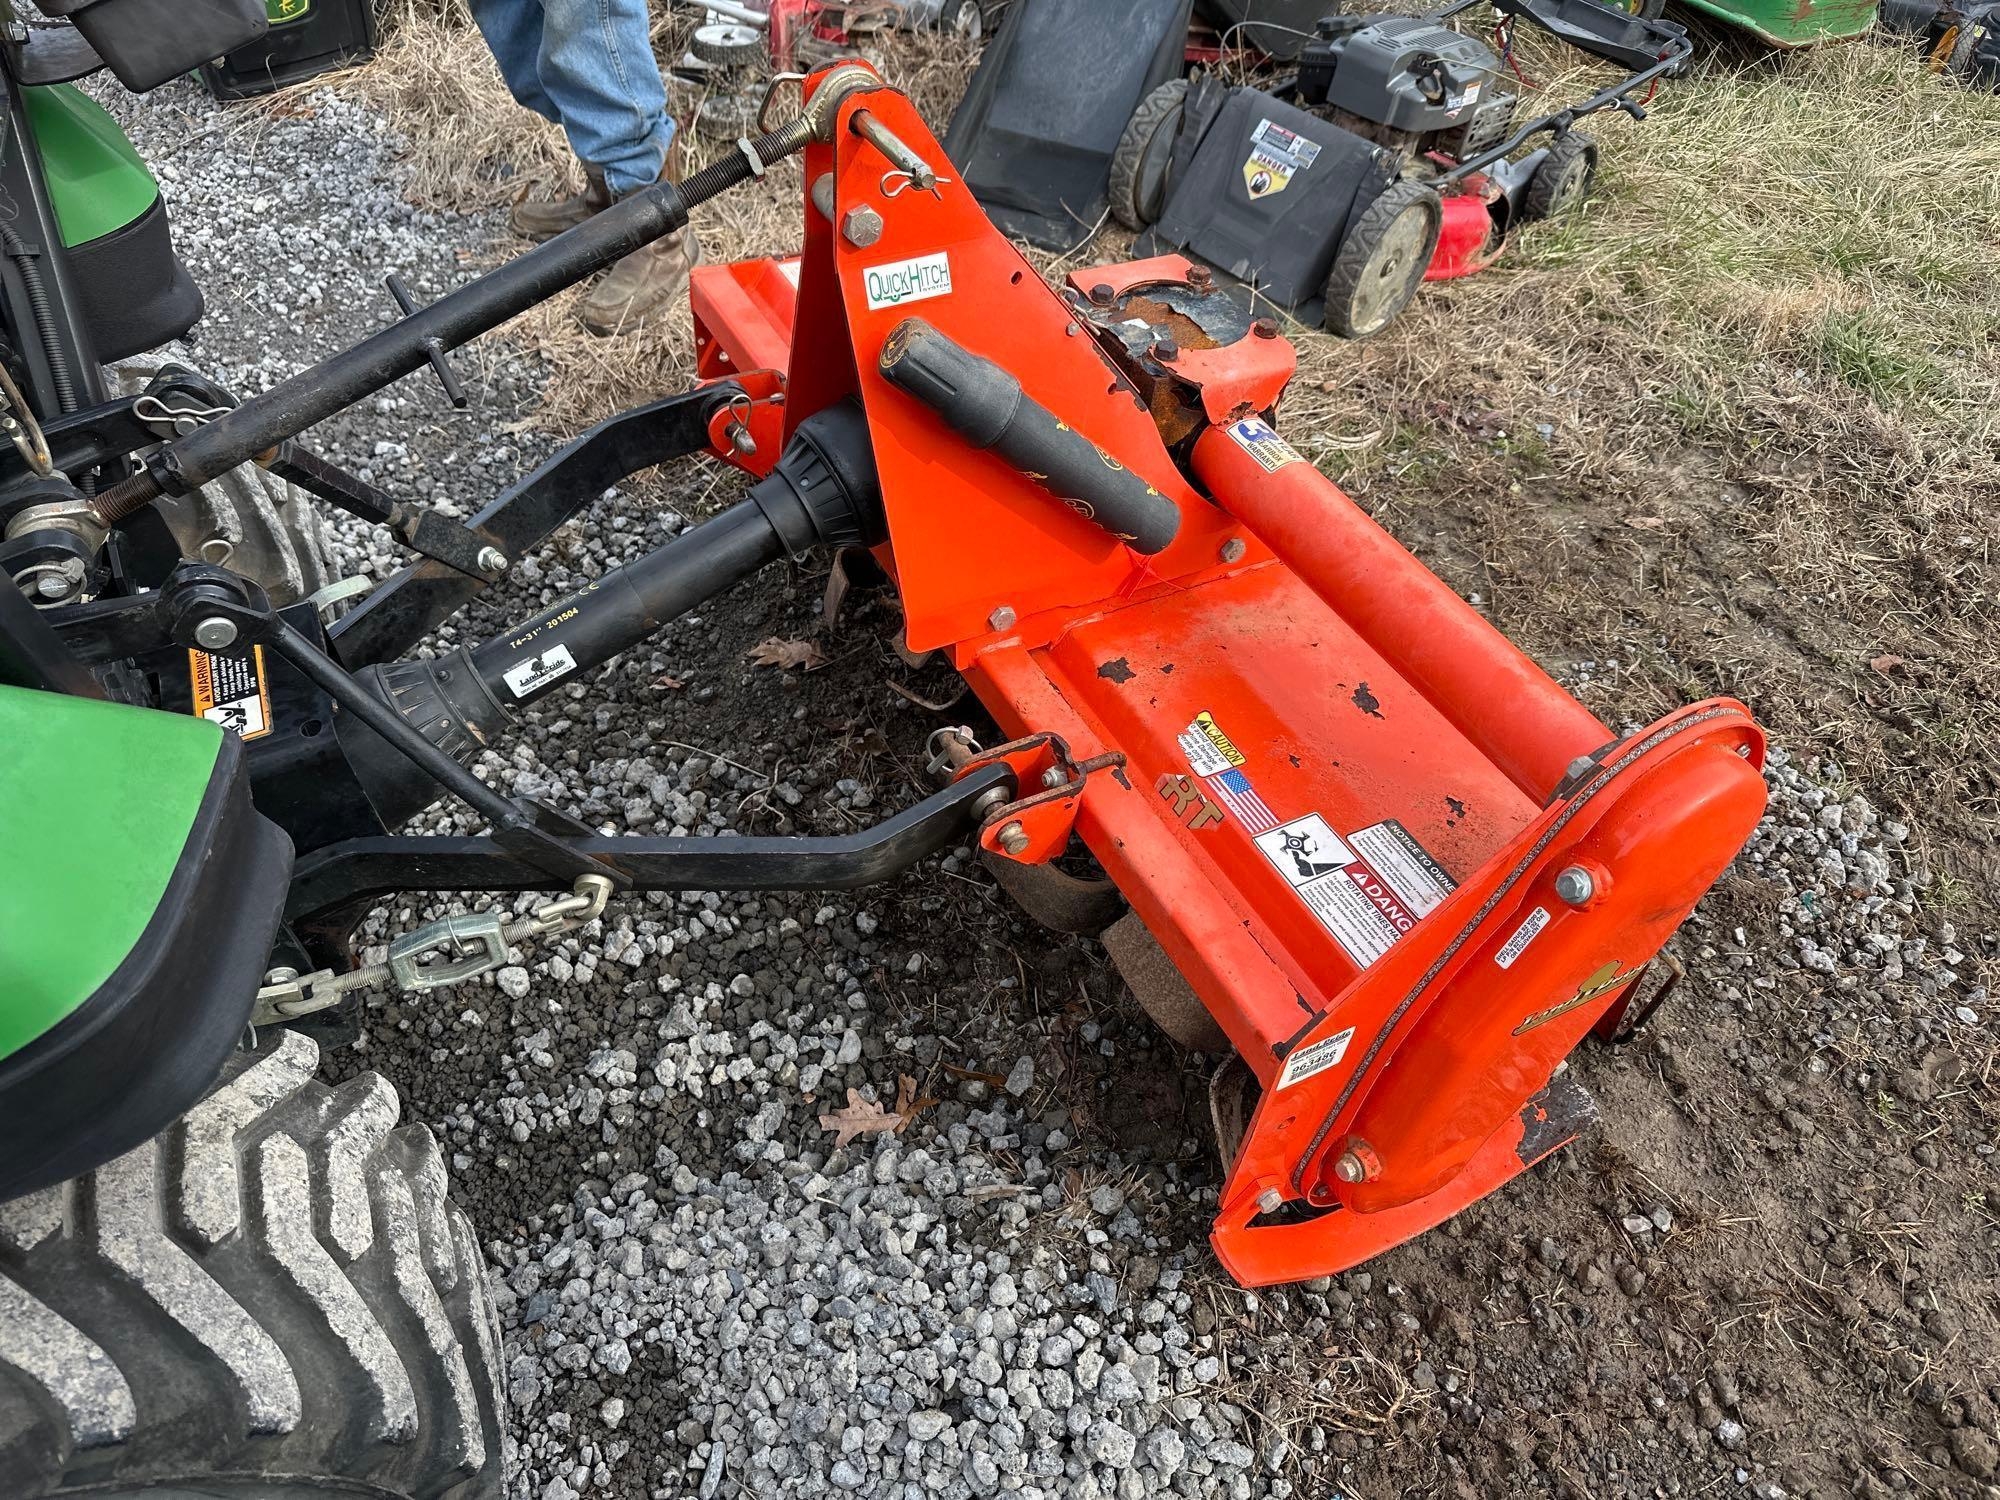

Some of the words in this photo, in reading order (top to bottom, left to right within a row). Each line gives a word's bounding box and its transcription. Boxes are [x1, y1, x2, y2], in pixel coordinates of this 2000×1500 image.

[1257, 154, 1288, 173] DANGER
[1247, 442, 1278, 468] WARRANTY
[546, 607, 579, 629] 201504
[195, 651, 211, 695] WARNING
[519, 672, 538, 686] Land
[1193, 727, 1208, 743] avoid
[1205, 727, 1243, 763] CAUTION
[1390, 824, 1421, 854] NOTICE
[1417, 854, 1432, 867] TO
[1342, 878, 1373, 910] ROTATING
[1371, 909, 1390, 929] TINES
[1365, 883, 1412, 932] DANG
[1516, 923, 1541, 951] EQUIVALENT
[1496, 947, 1508, 960] SHELL
